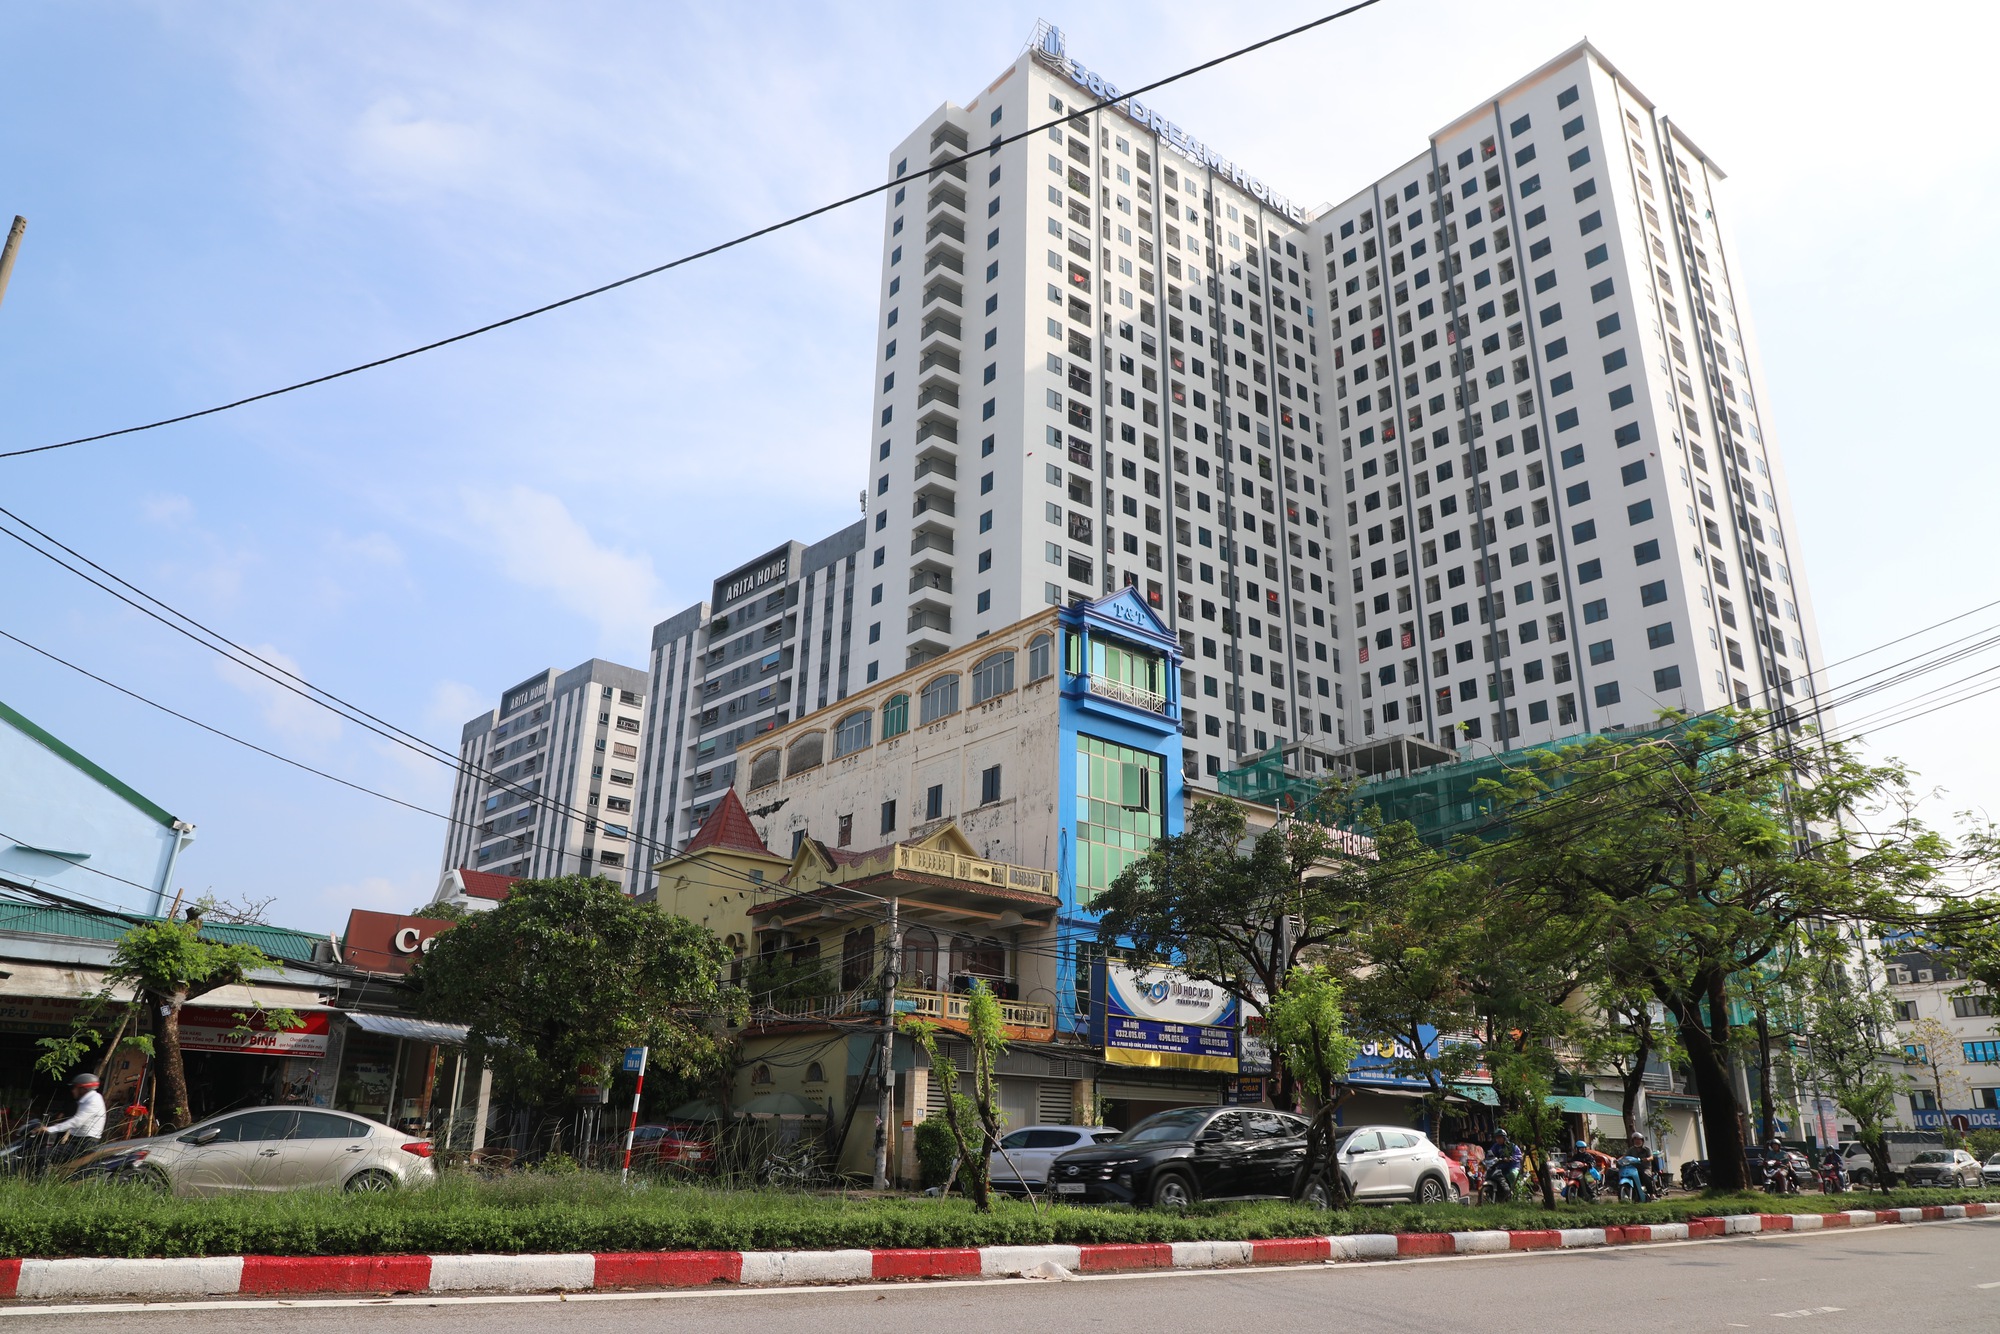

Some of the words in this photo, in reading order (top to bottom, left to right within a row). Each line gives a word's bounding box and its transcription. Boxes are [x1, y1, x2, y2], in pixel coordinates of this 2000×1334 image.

[1070, 58, 1121, 107] 389
[1129, 96, 1225, 175] DREAM
[1231, 161, 1304, 226] HOME
[725, 574, 755, 603] ARITA
[757, 556, 788, 588] HOME
[1113, 601, 1147, 628] T&T
[509, 690, 529, 712] ARITA
[529, 681, 548, 703] HOME
[1242, 1084, 1259, 1092] CIGAR
